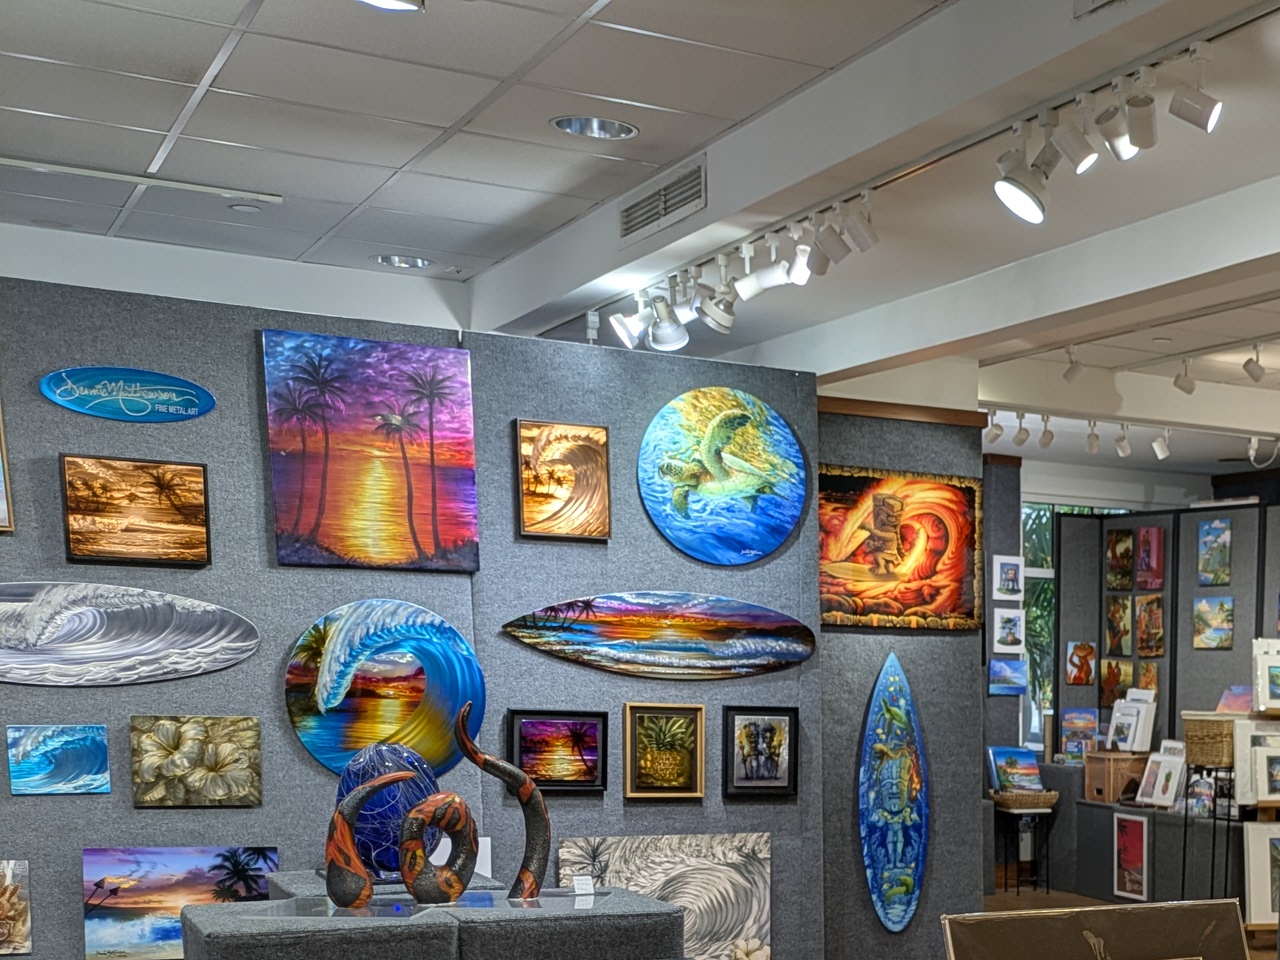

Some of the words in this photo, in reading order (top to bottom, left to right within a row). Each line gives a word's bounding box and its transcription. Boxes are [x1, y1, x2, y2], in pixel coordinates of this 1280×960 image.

[155, 403, 168, 413] FINE
[169, 405, 187, 415] METAL
[188, 407, 199, 416] ART
